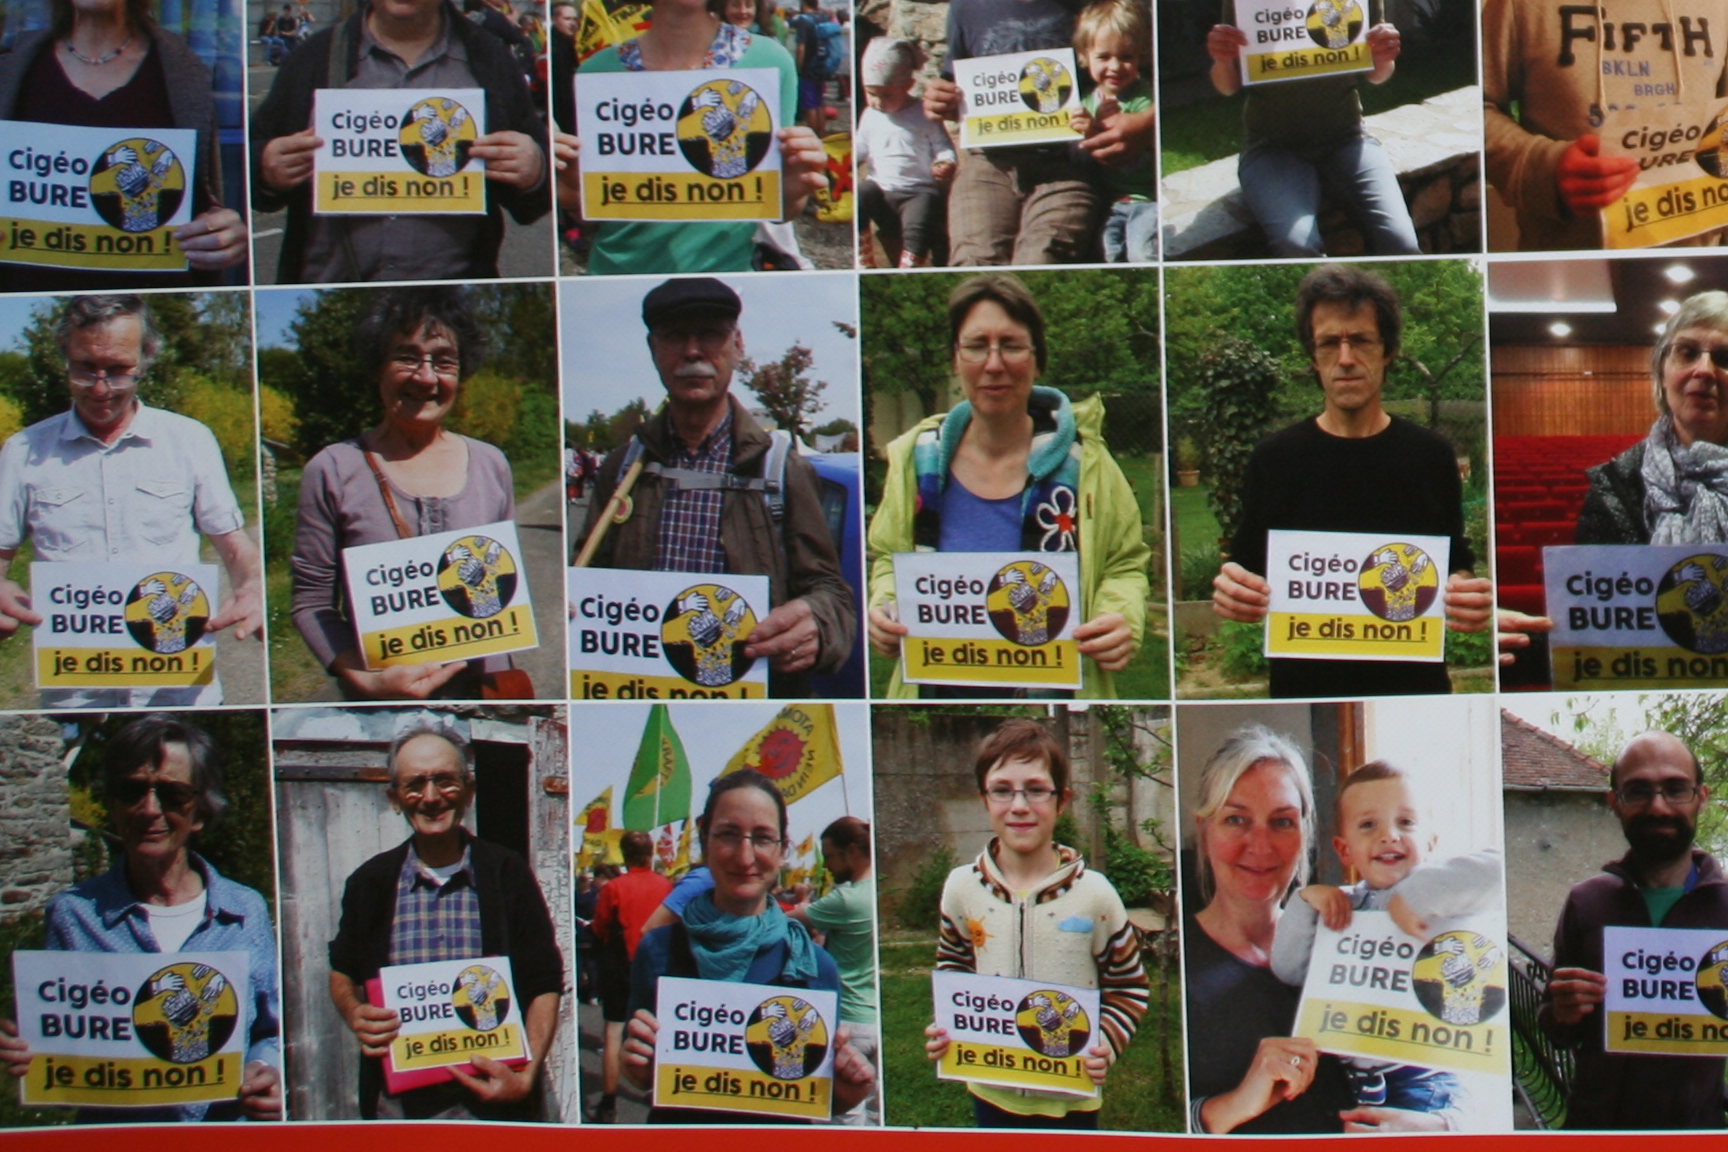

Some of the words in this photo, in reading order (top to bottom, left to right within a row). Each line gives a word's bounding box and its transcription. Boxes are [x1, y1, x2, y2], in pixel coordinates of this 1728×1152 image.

[332, 110, 398, 134] Cigéo
[596, 98, 674, 127] Cigéo
[333, 139, 397, 157] BURE
[598, 133, 675, 155] BURE
[332, 175, 354, 200] je
[363, 175, 398, 198] dis
[406, 181, 453, 198] non
[600, 176, 627, 205] je
[636, 176, 677, 201] dis
[688, 182, 744, 202] non
[50, 584, 123, 609] Cigéo
[916, 574, 984, 600] Cigéo
[52, 614, 123, 634] BURE
[918, 604, 986, 624] BURE
[54, 651, 78, 676] je
[86, 650, 123, 672] dis
[132, 654, 183, 671] non
[922, 640, 945, 666] je
[953, 641, 988, 664] dis
[996, 647, 1047, 666] non
[38, 978, 130, 1010] Cigéo
[41, 1014, 131, 1040] BURE
[675, 1001, 744, 1027] Cigéo
[674, 1031, 744, 1054] BURE
[45, 1059, 74, 1089] je
[84, 1059, 133, 1087] dis
[143, 1066, 206, 1086] non
[673, 1069, 698, 1095] je
[706, 1071, 742, 1094] dis
[751, 1079, 800, 1099] non
